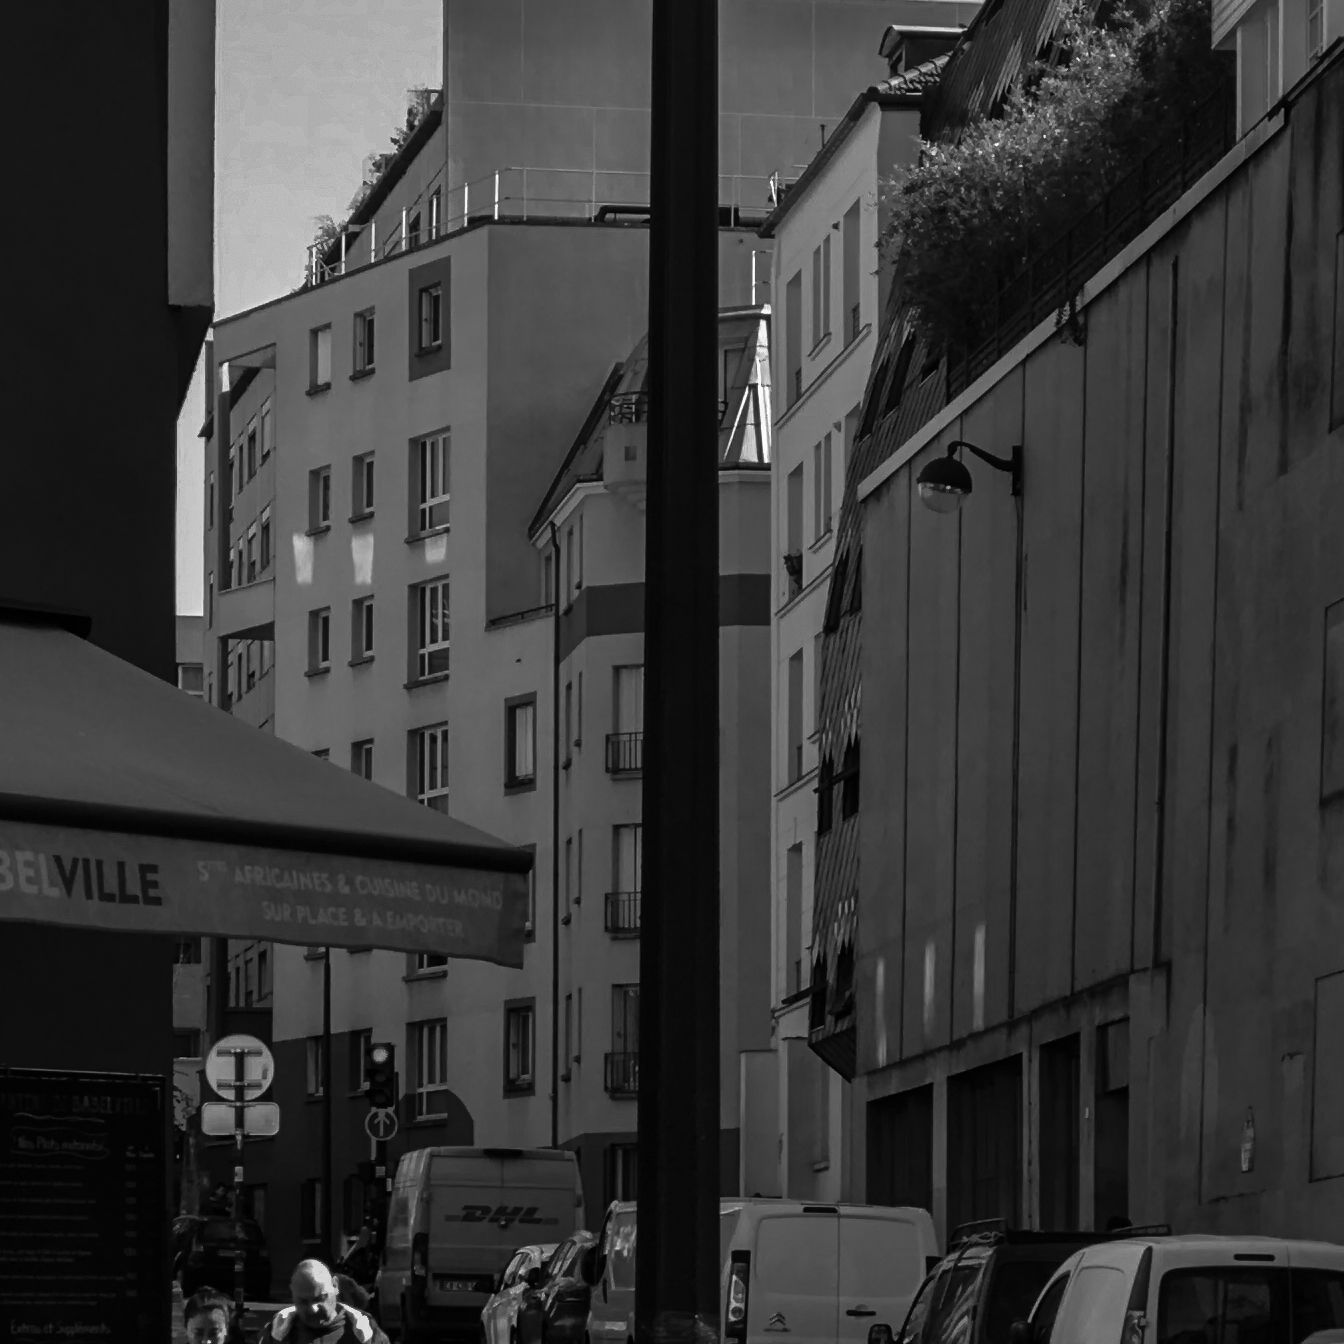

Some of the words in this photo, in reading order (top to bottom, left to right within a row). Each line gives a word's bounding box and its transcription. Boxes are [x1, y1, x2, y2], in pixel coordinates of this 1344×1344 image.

[234, 865, 333, 895] AFRICAINES
[337, 876, 351, 895] &
[355, 875, 422, 902] CUISINE
[426, 883, 449, 905] DU
[453, 887, 503, 910] MOND
[261, 901, 291, 923] SUR
[296, 905, 349, 927] PLACE
[354, 907, 367, 927] &
[386, 911, 464, 938] EMPORTER
[461, 1205, 543, 1224] DHL
